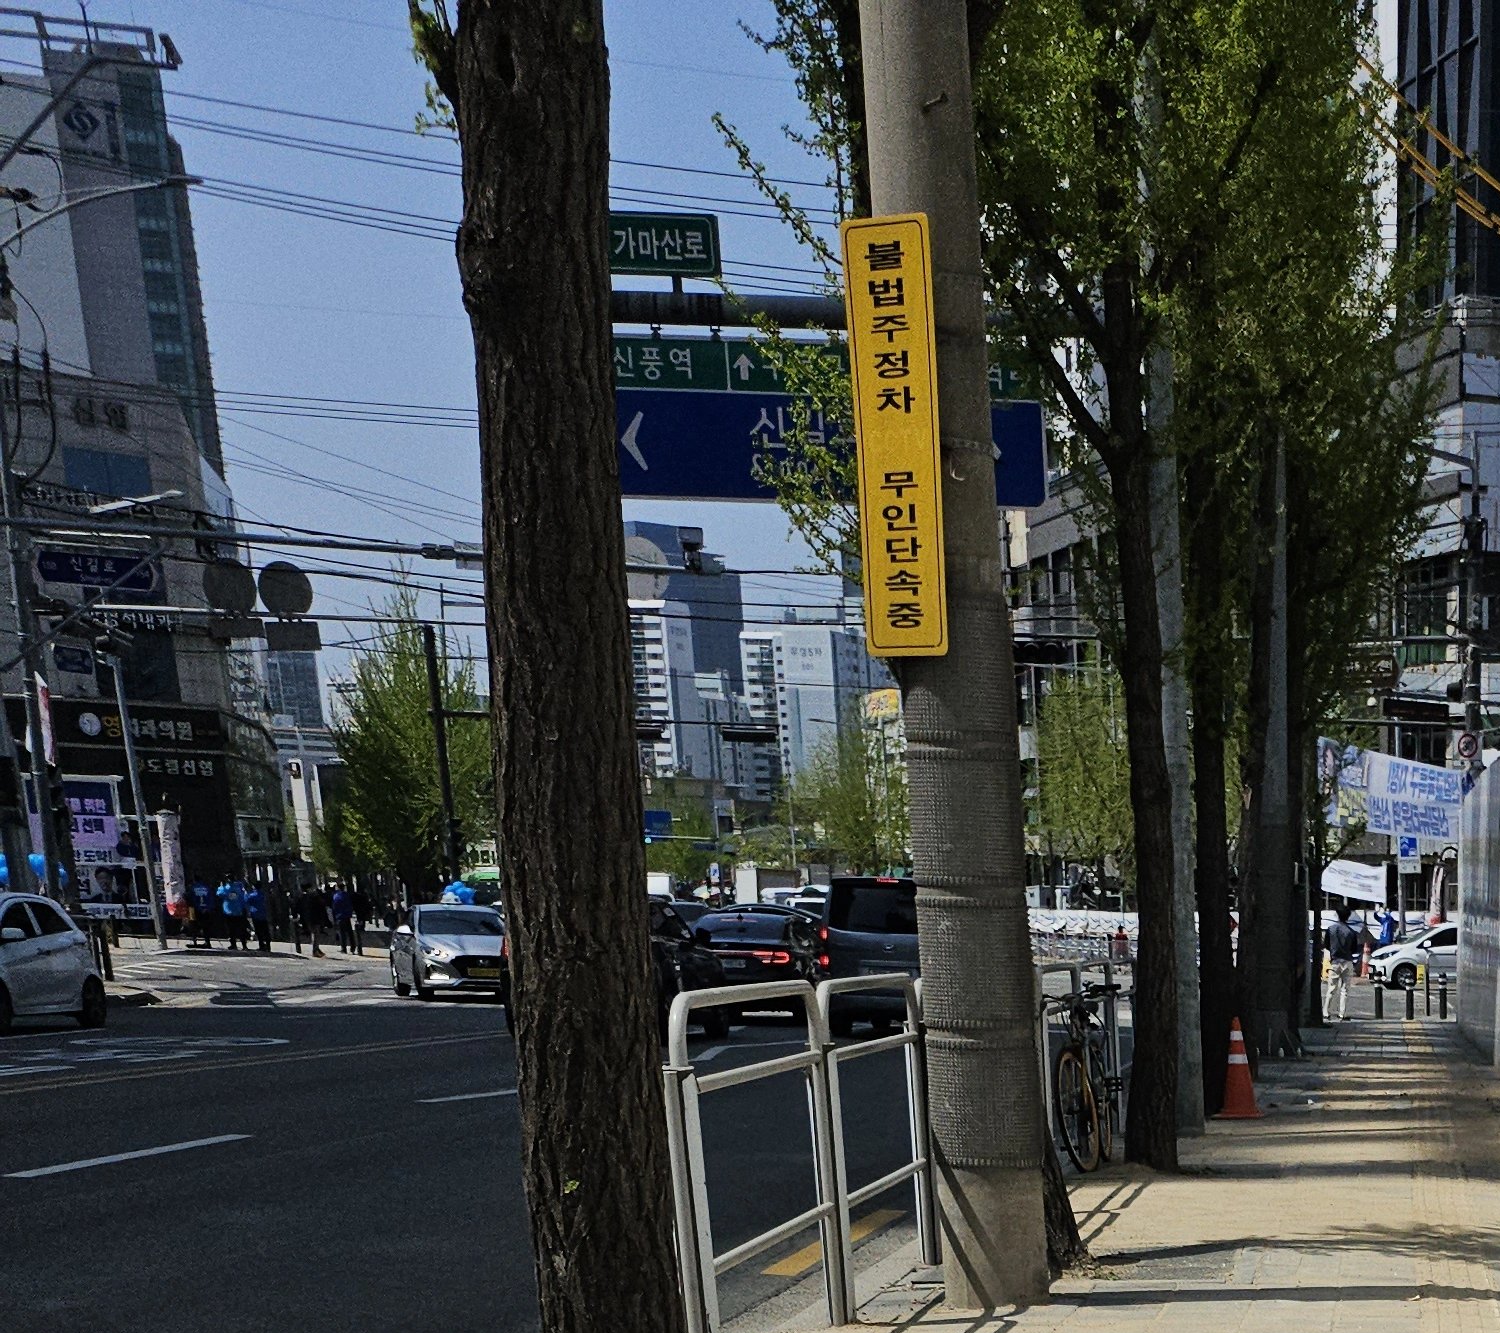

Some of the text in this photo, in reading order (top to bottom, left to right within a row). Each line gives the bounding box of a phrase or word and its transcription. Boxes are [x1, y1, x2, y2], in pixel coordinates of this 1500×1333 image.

[613, 226, 708, 261] 가마산로
[864, 239, 917, 415] 불법주정차
[613, 345, 693, 381] 신풍역
[879, 470, 925, 629] 무인단속중
[146, 758, 214, 777] 도림신협
